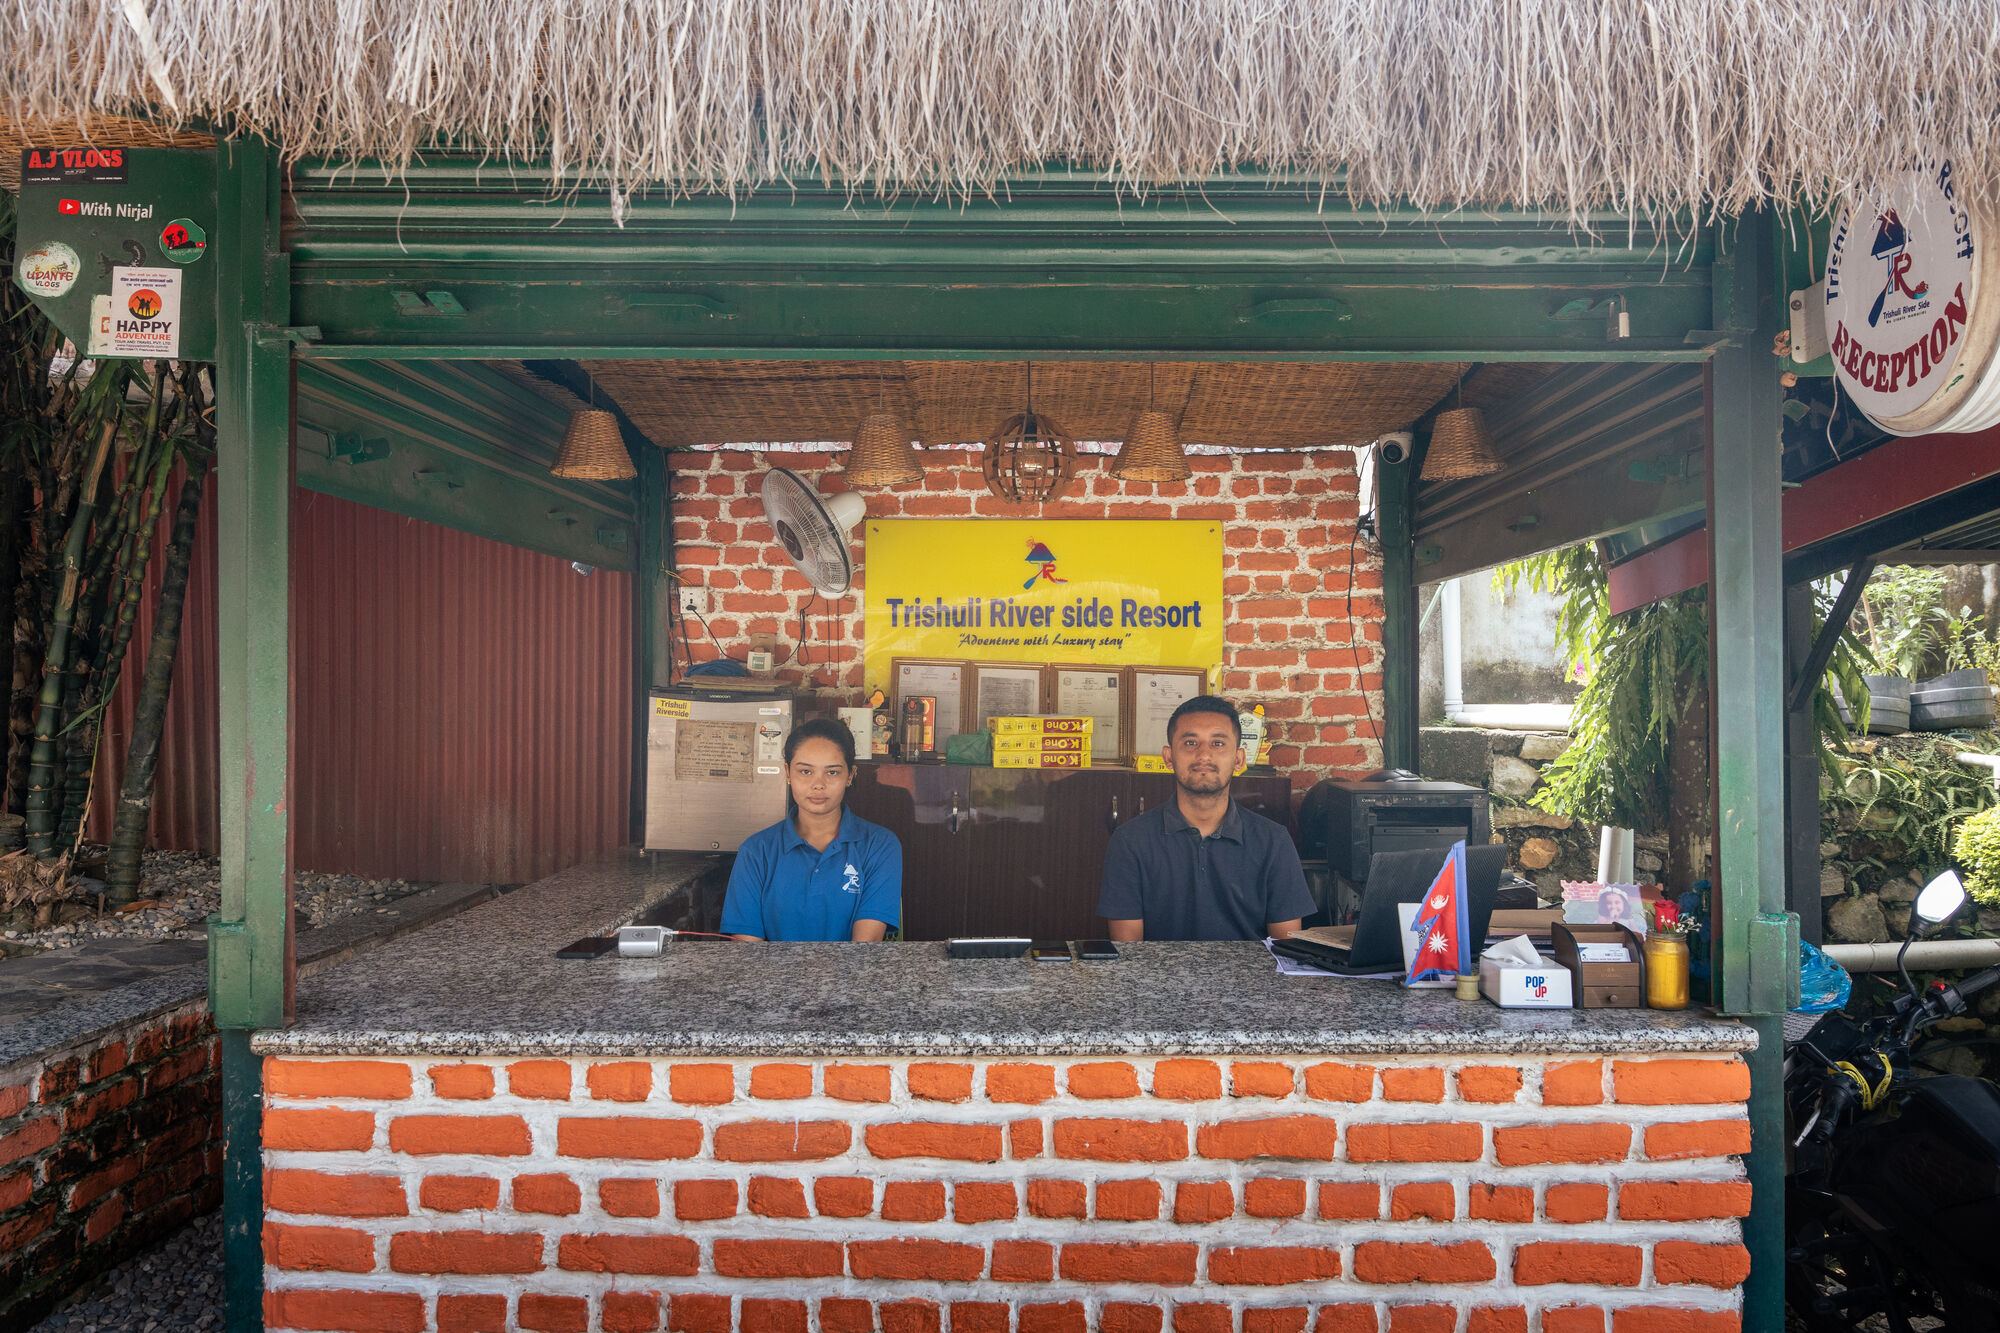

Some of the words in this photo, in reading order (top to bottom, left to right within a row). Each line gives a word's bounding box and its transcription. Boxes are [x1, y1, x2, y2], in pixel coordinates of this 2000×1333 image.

[62, 149, 123, 168] VLOGS
[80, 202, 112, 217] With
[116, 203, 153, 222] Nirjal
[26, 270, 73, 282] UDANTE
[1902, 305, 1917, 314] River
[1918, 300, 1930, 310] Side
[117, 320, 172, 333] HAPPY
[115, 332, 172, 341] ADVENTURE
[1832, 282, 1967, 393] RECEPTION
[886, 597, 982, 628] Trishuli
[989, 598, 1056, 628] River
[1061, 598, 1114, 628] side
[1121, 599, 1202, 628] Resort
[1023, 634, 1049, 646] with
[1051, 633, 1095, 649] Luxury
[661, 700, 688, 709] Trishuli
[656, 707, 690, 718] Riverside
[1046, 721, 1081, 731] K.One
[1044, 738, 1079, 749] K.One
[1043, 755, 1079, 765] K.One
[1525, 976, 1545, 988] POP
[1535, 986, 1548, 998] UP
